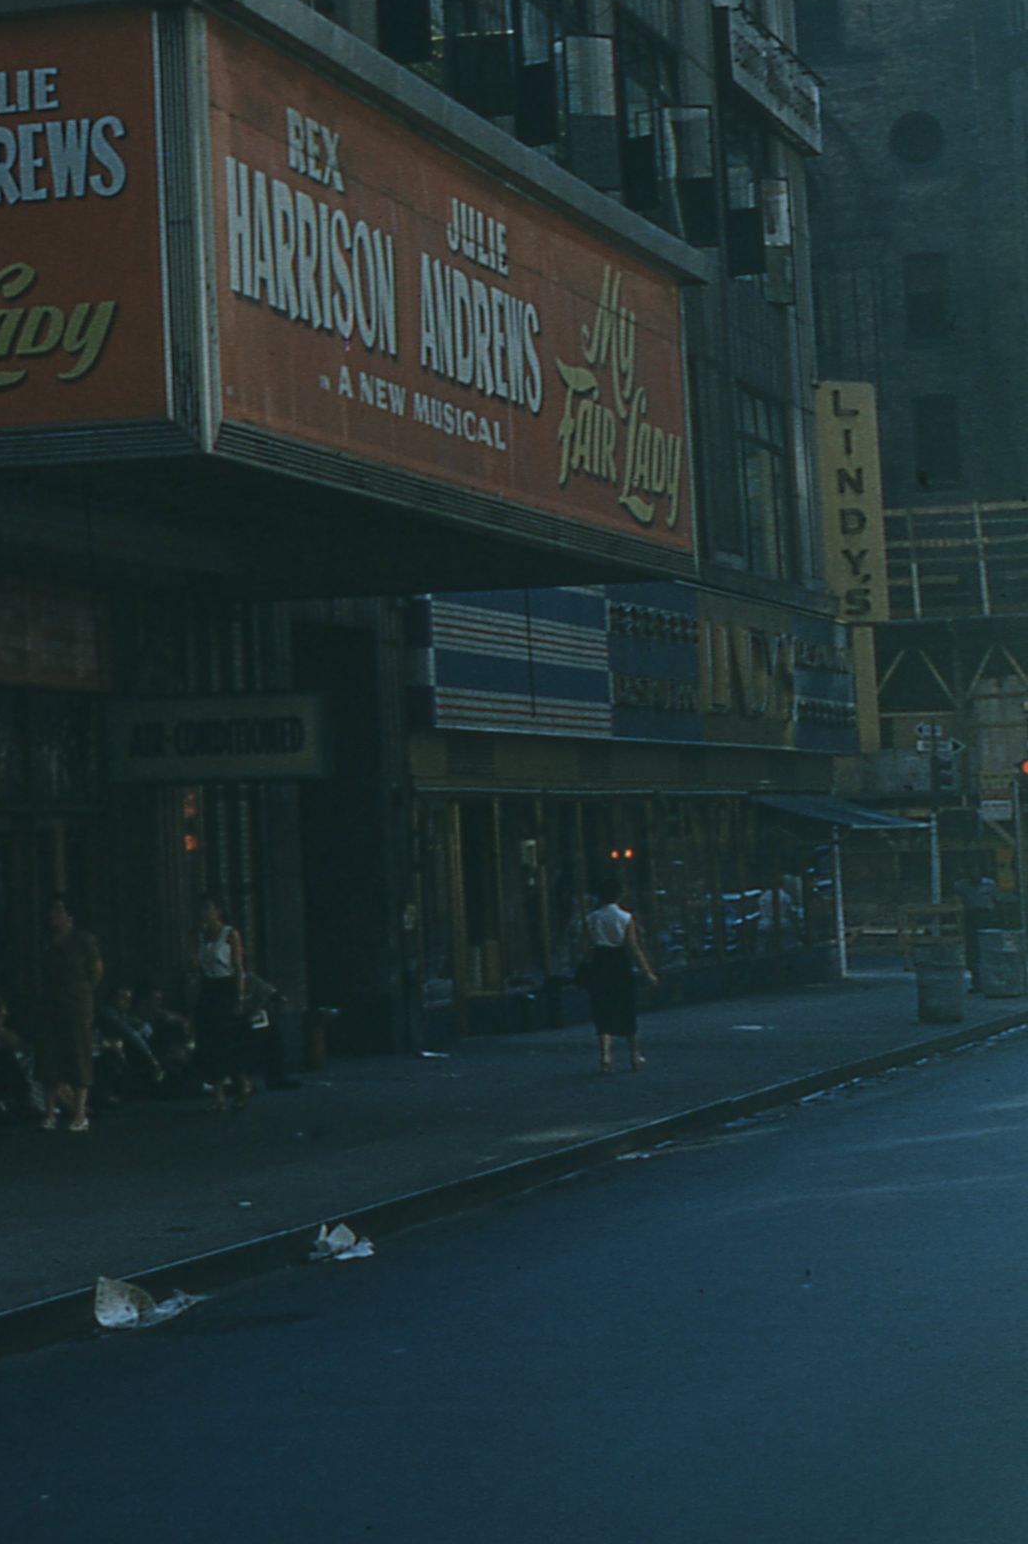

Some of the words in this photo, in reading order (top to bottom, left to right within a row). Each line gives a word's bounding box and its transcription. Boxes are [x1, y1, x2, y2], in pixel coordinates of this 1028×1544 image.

[286, 106, 345, 193] REX
[225, 156, 398, 356] HARRISON
[447, 197, 509, 276] JULIE
[421, 252, 544, 414] ANDREWS
[338, 365, 354, 399] A
[359, 372, 407, 417] NEW
[413, 392, 508, 451] MUSICAL
[831, 389, 872, 617] LINDY'S
